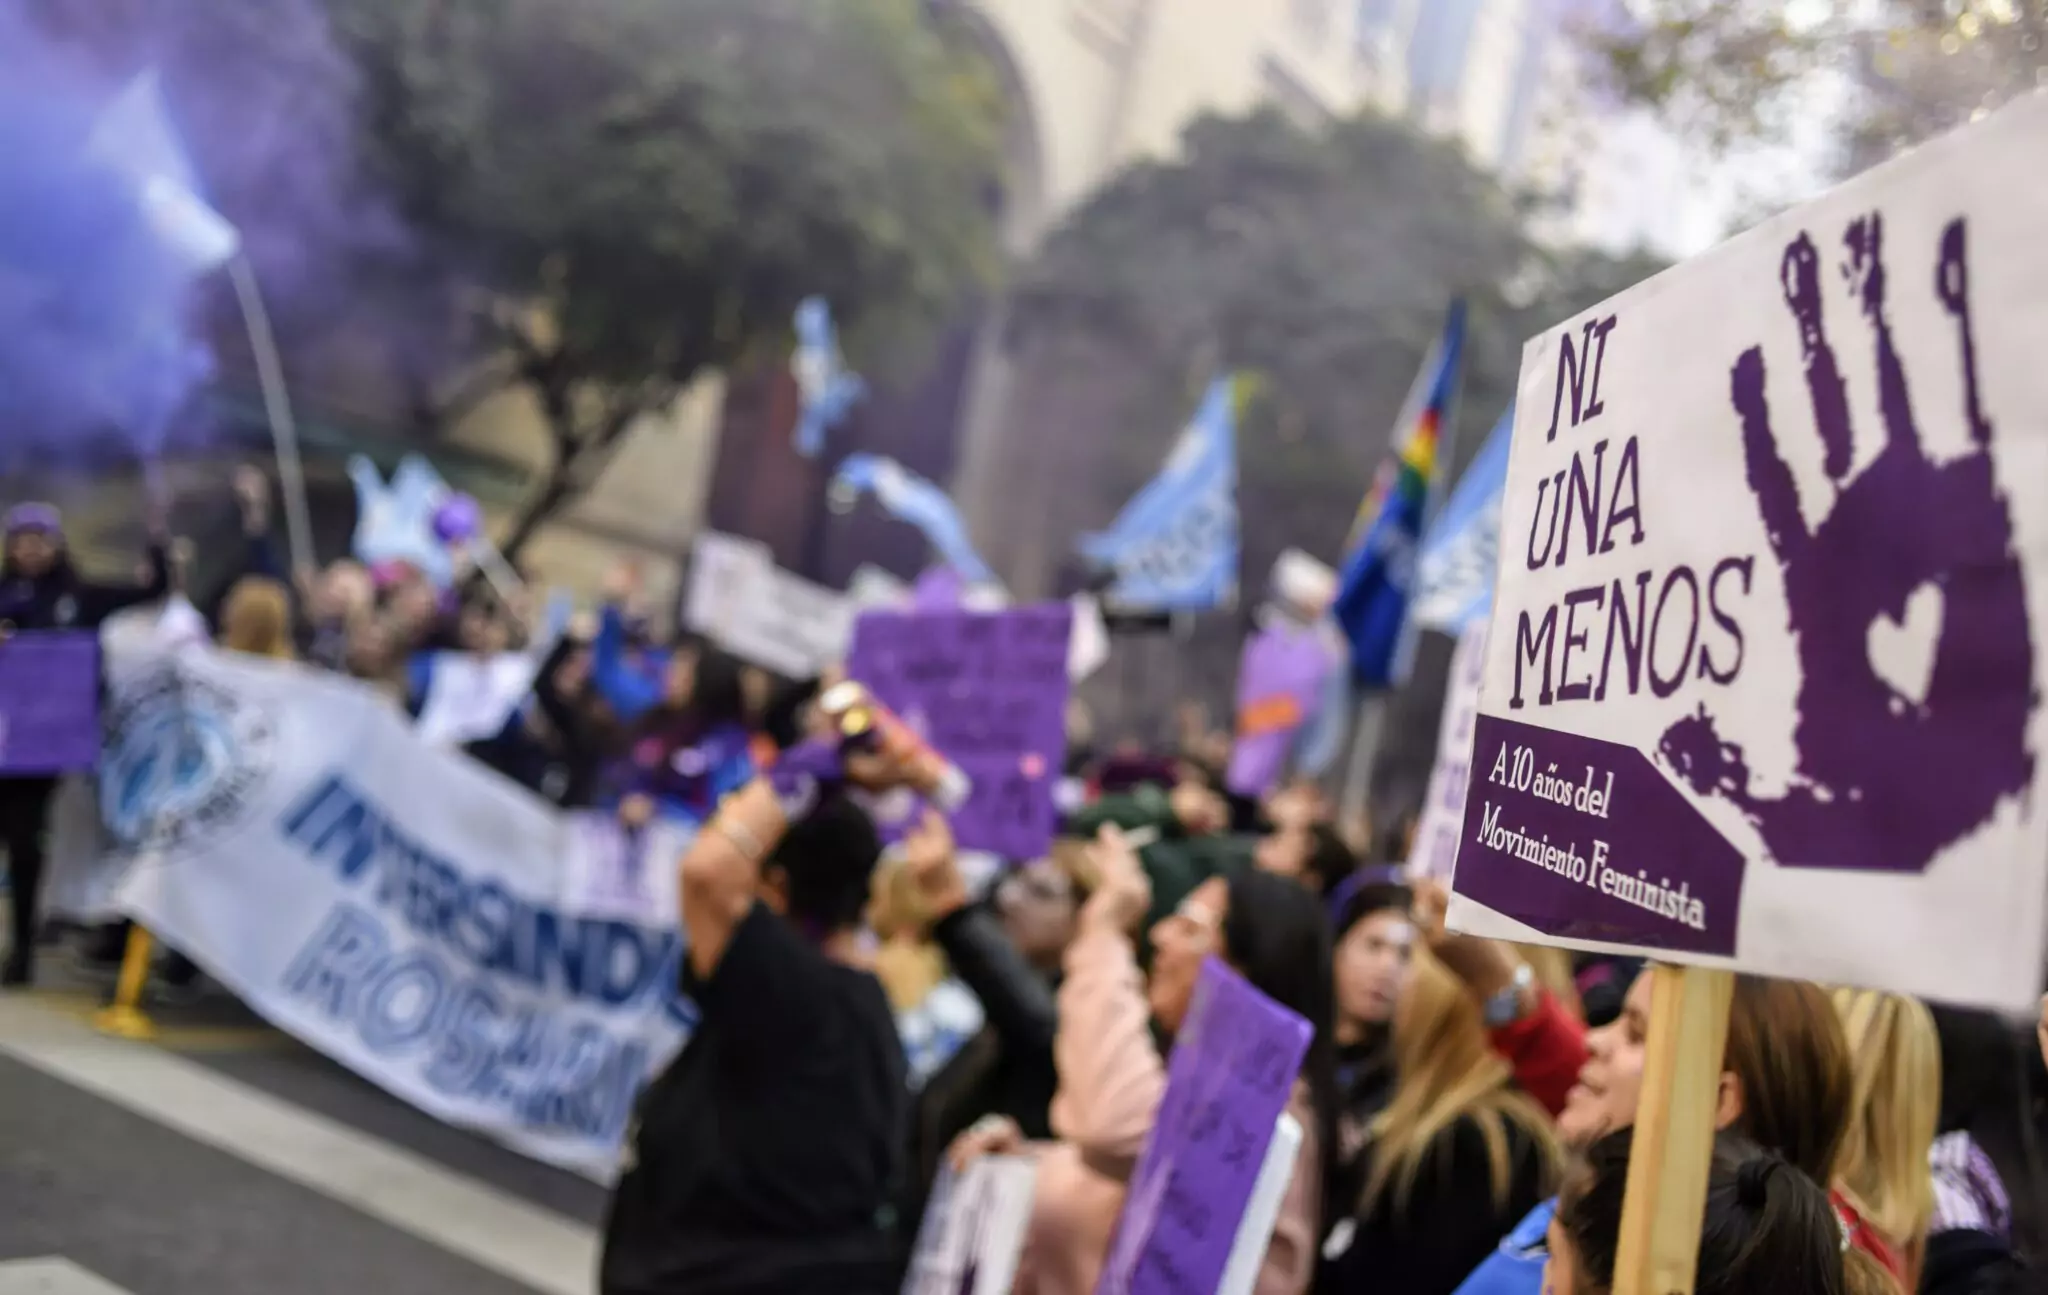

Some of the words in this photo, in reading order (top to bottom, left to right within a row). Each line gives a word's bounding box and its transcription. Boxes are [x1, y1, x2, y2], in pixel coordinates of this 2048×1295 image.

[1547, 314, 1617, 442] NI
[1527, 435, 1644, 571] UNA
[1509, 555, 1754, 710] MENOS
[1533, 762, 1573, 807] años
[1574, 765, 1614, 819] del
[1477, 801, 1586, 883] Movimiento
[1586, 839, 1706, 931] Feminista
